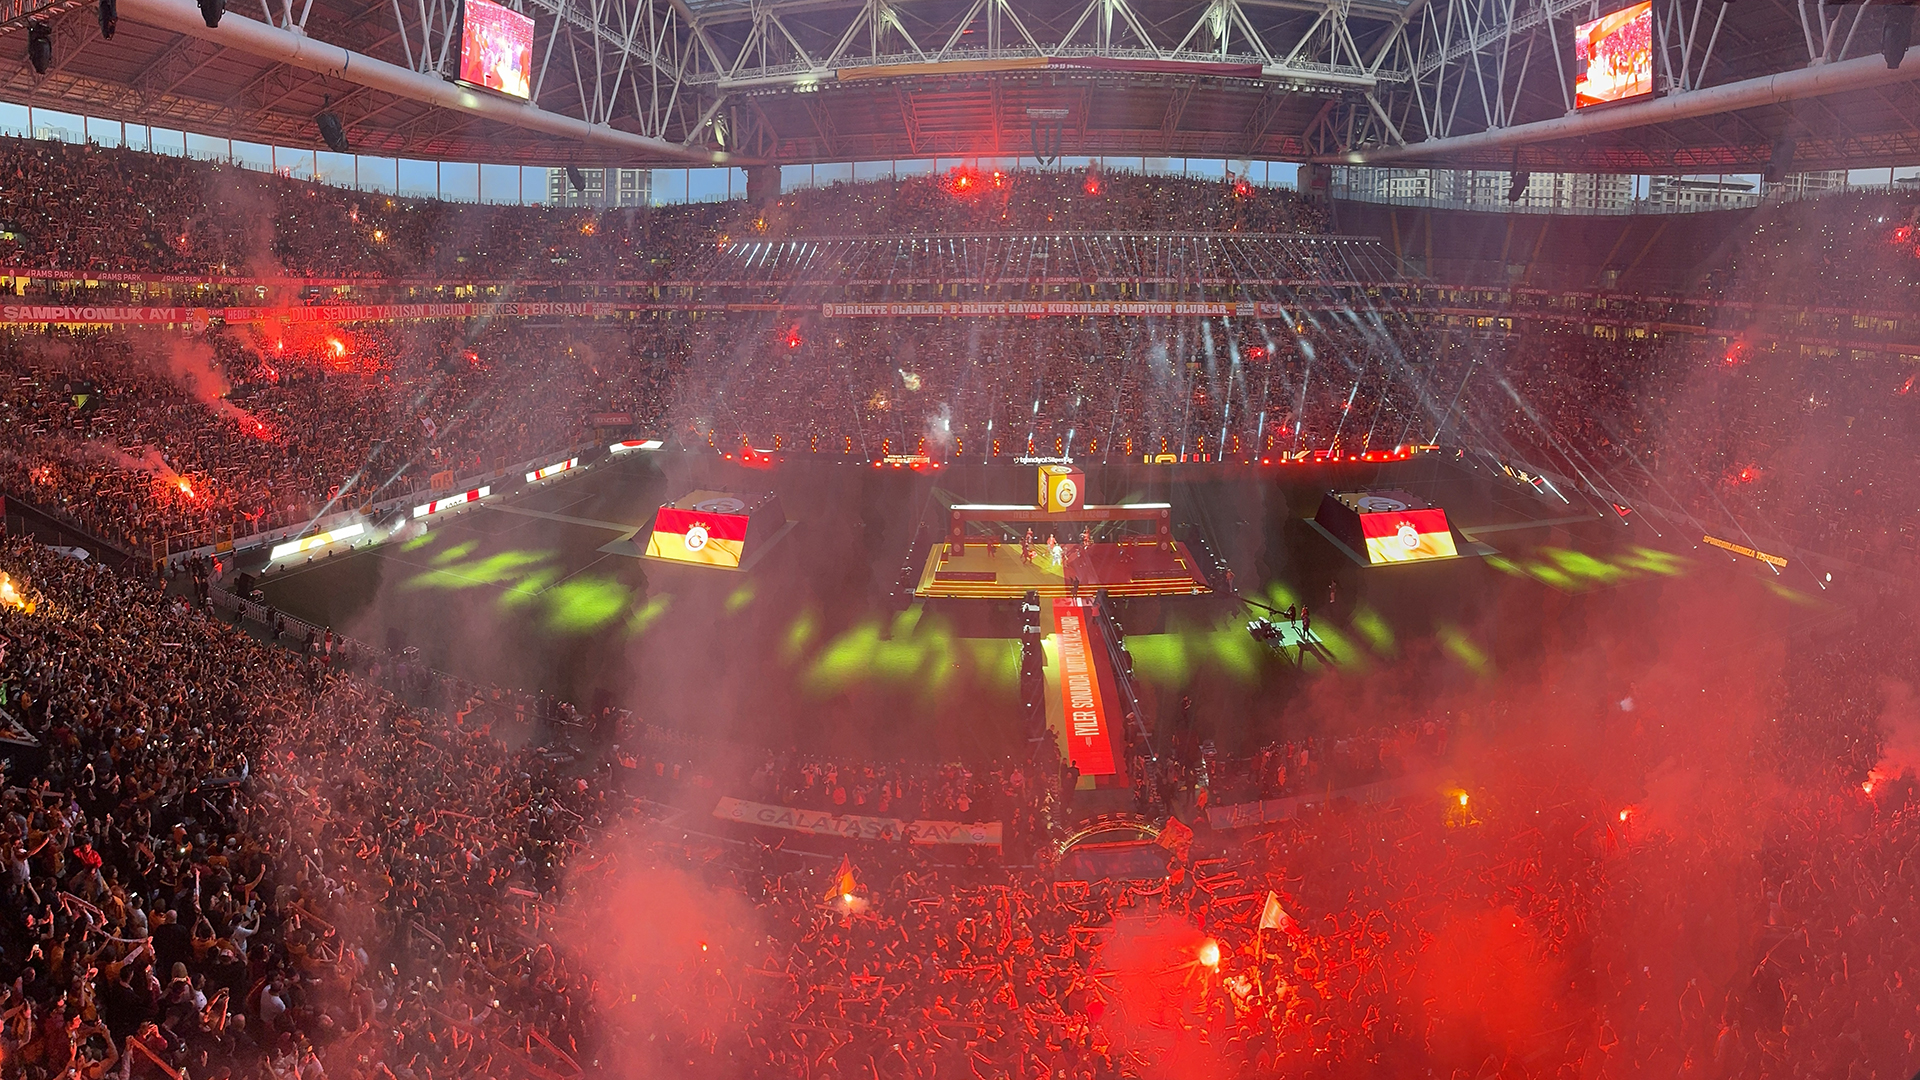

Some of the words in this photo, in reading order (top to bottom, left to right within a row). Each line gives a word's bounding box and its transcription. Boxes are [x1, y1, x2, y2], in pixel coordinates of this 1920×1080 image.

[31, 270, 53, 278] RAMS
[56, 271, 74, 279] PARK
[4, 305, 144, 322] ŞAMPİYONLUK
[150, 308, 176, 320] AYI
[471, 303, 519, 315] HERKES
[836, 303, 888, 314] BİRLİKTE
[1009, 303, 1045, 313] HAYAL
[1048, 303, 1109, 313] KURANLAR
[1113, 302, 1173, 315] ŞAMPİYON
[1175, 303, 1230, 314] OLURLAR.
[1063, 642, 1089, 673] MUTLAKA
[1068, 673, 1095, 709] SONUNDA
[1072, 710, 1100, 736] İYİLER
[757, 808, 961, 840] GALATASARAY
